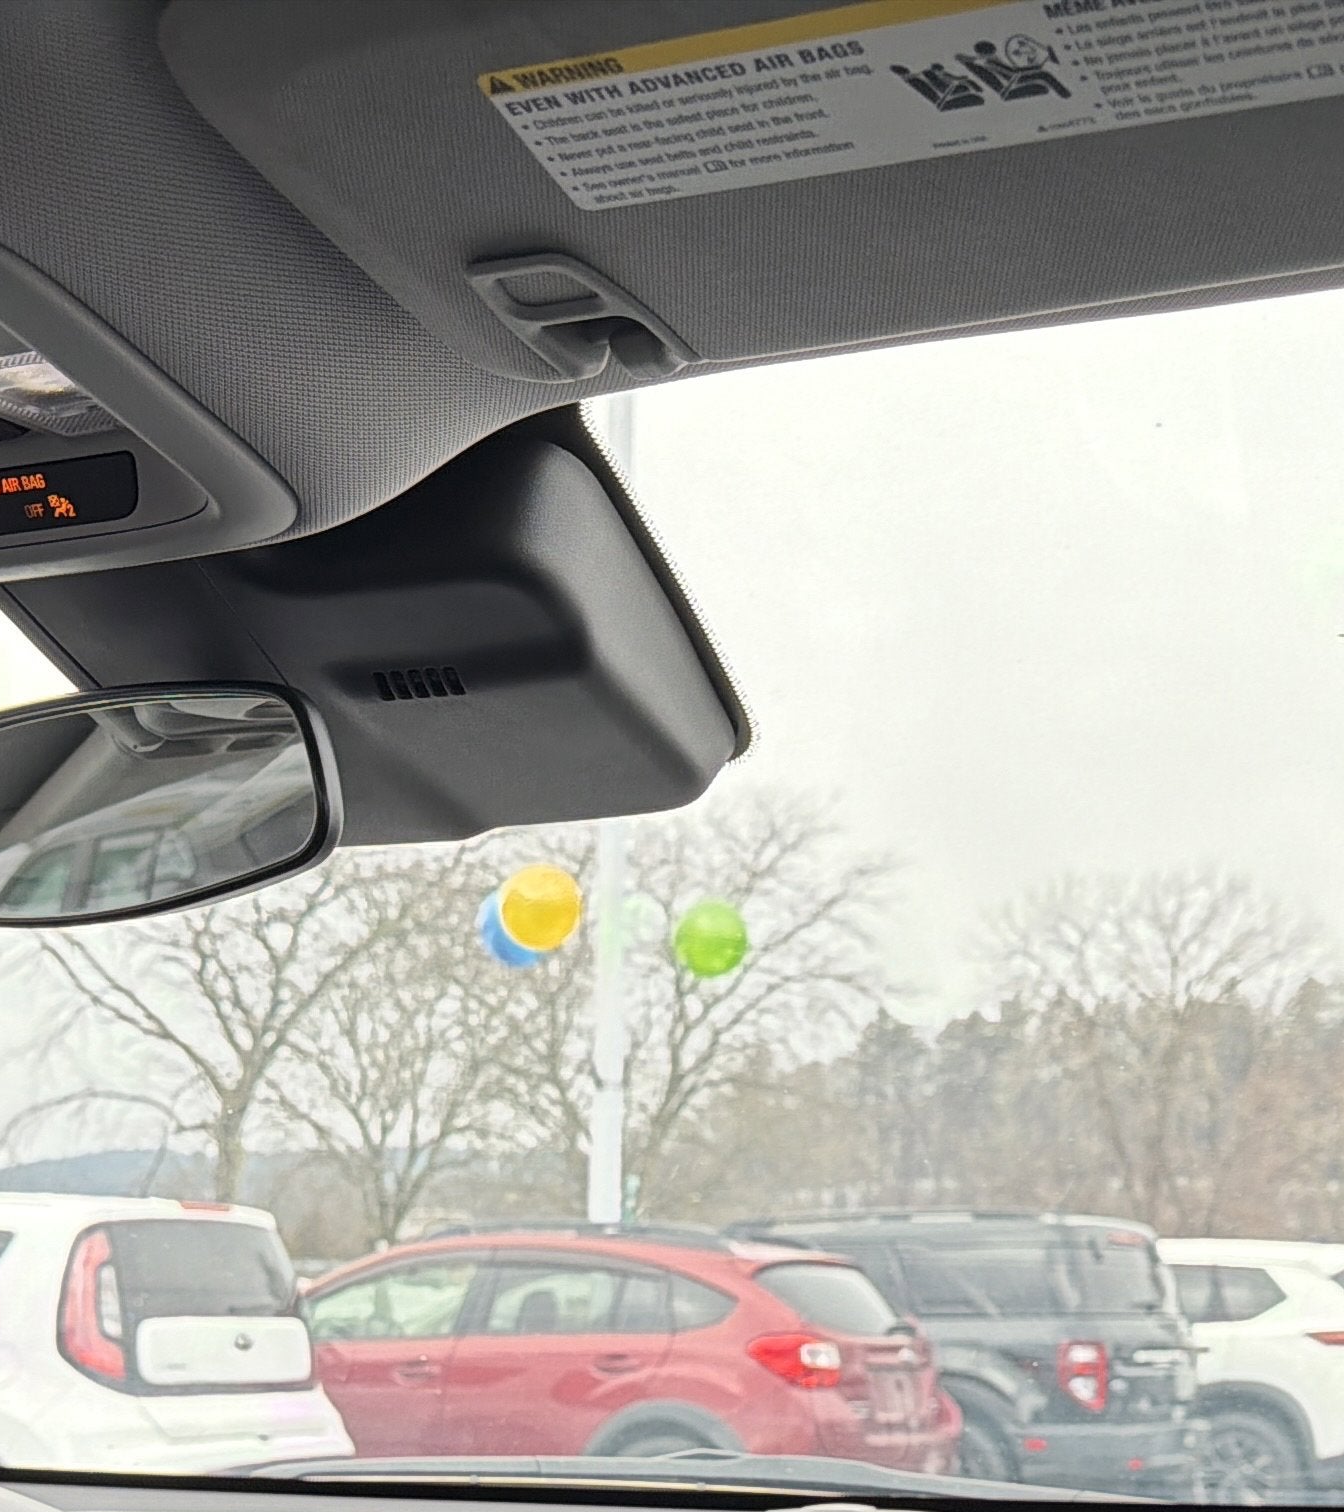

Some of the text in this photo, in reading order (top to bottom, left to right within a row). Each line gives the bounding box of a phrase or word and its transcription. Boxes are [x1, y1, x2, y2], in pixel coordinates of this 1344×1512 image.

[505, 40, 865, 116] EVEN WITH ADVANCED AIR BAGS
[512, 57, 624, 89] WARNING
[533, 115, 584, 130] Children
[585, 111, 607, 122] can
[678, 88, 733, 105] seriously
[735, 78, 779, 96] injured
[799, 73, 821, 83] the
[824, 69, 841, 80] air
[544, 135, 569, 146] The
[570, 130, 599, 142] back
[601, 125, 628, 138] seat
[643, 119, 665, 130] the
[666, 112, 702, 127] safest
[704, 106, 739, 121] place
[740, 102, 759, 113] for
[557, 150, 593, 162] Never
[595, 145, 615, 158] put
[696, 126, 727, 140] child
[727, 121, 756, 134] seat
[771, 116, 794, 127] the
[571, 163, 614, 178] Always
[698, 145, 723, 157] and
[724, 139, 755, 152] child
[728, 158, 747, 169] for
[748, 153, 782, 165] more
[782, 141, 855, 160] information
[2, 476, 21, 493] AIR
[22, 473, 46, 490] BAG
[24, 503, 44, 519] OFF
